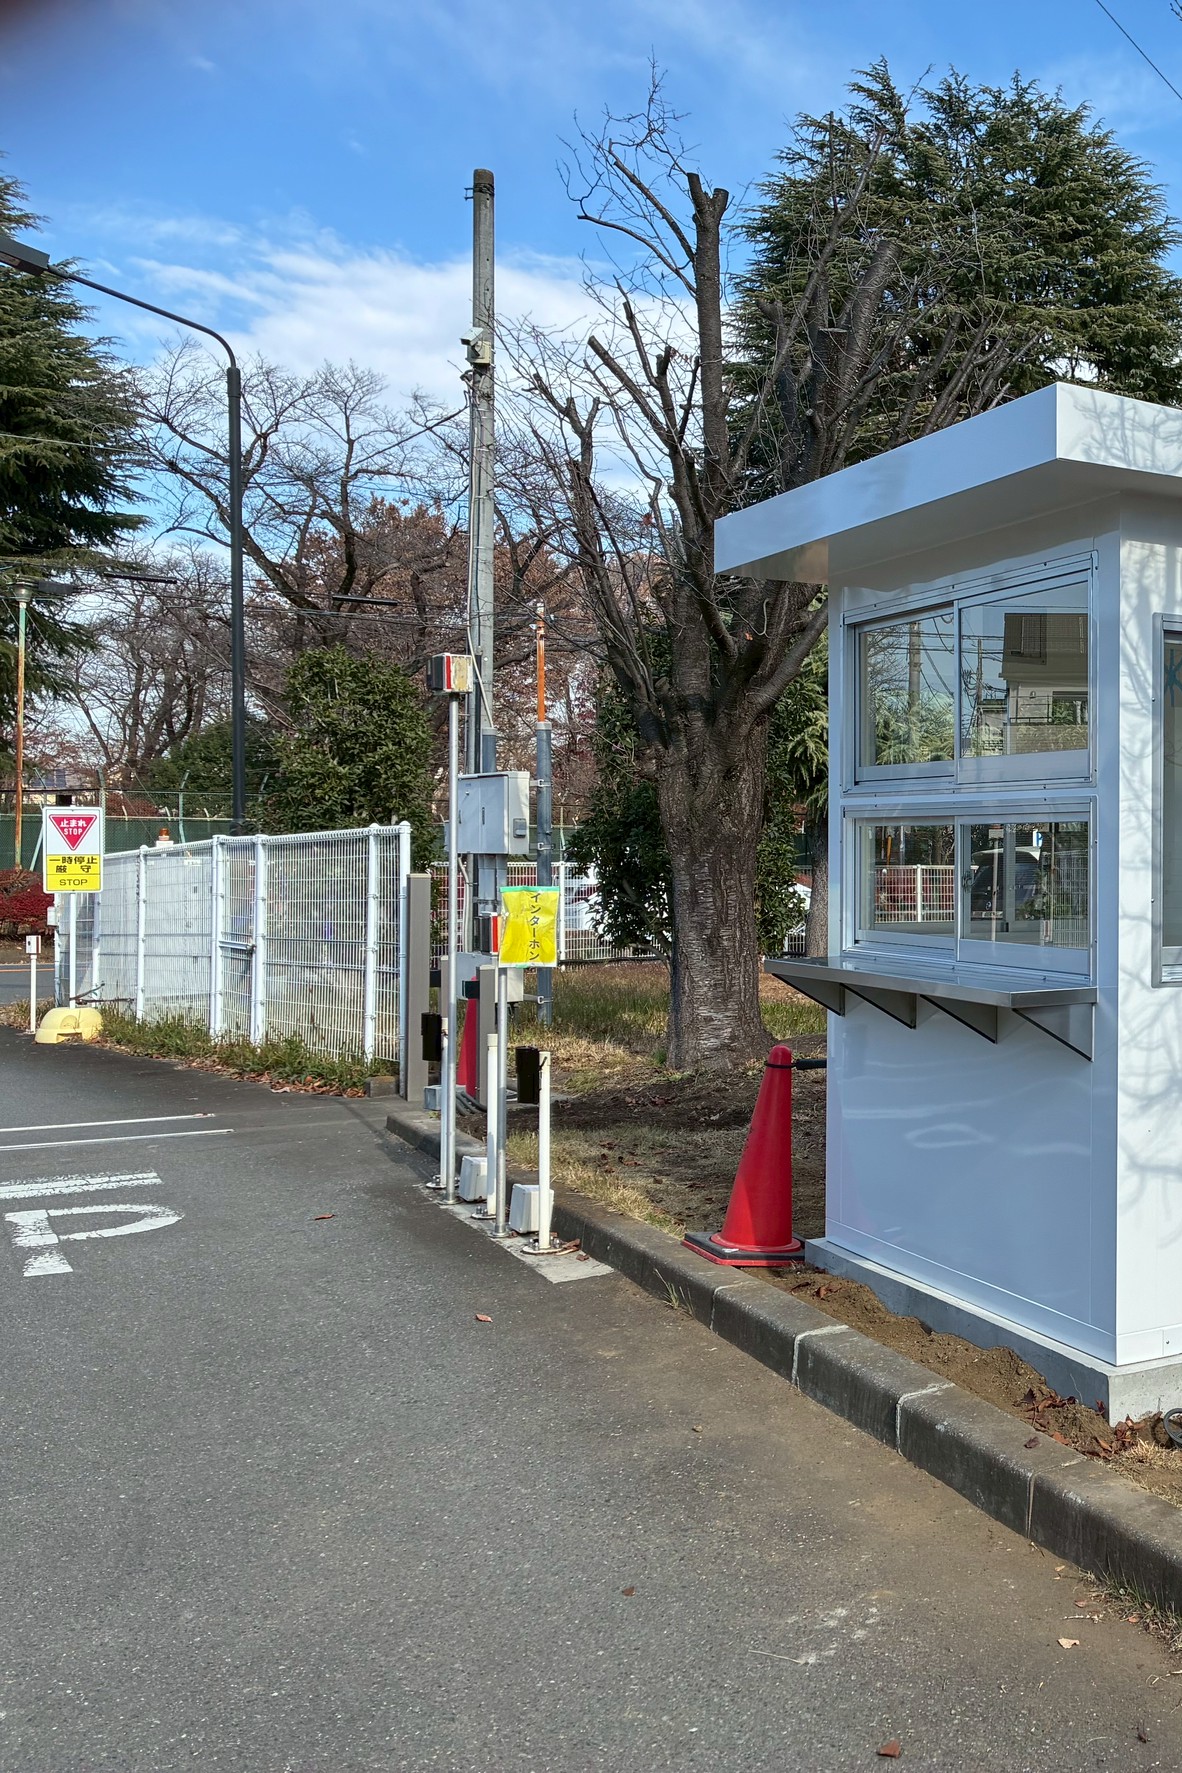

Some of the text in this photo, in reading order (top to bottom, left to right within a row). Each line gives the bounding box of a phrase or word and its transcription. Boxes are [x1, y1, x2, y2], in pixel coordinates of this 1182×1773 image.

[60, 818, 88, 828] 止まれ
[63, 828, 83, 836] STOP
[49, 856, 98, 864] 一時停止
[59, 878, 88, 886] STOP
[528, 892, 542, 961] インターホン
